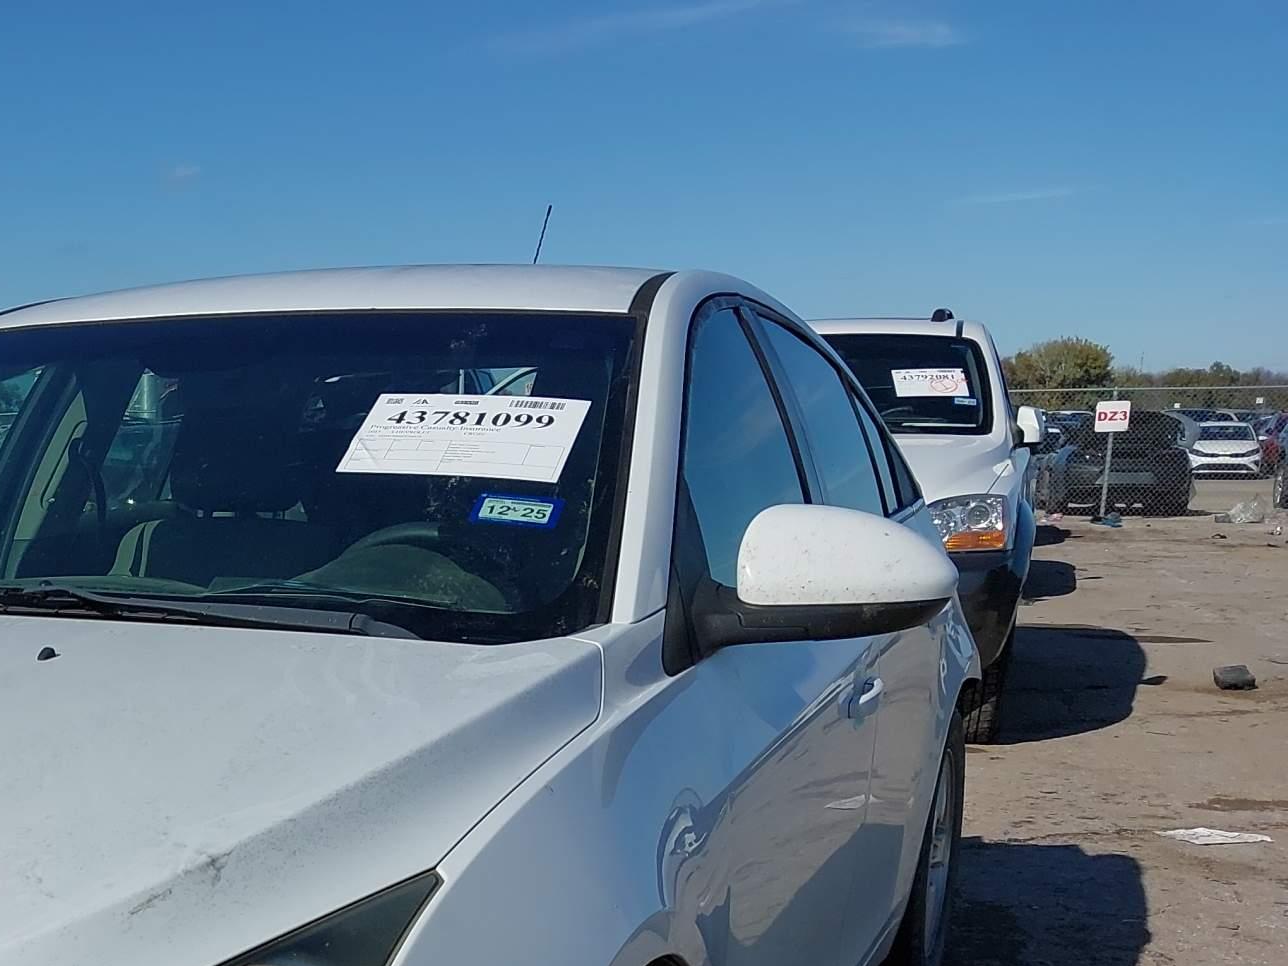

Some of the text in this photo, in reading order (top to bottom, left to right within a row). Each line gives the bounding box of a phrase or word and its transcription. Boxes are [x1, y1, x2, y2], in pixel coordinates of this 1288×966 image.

[386, 410, 555, 430] 43781099
[1097, 410, 1128, 422] DZ3
[487, 504, 548, 520] 12 25
